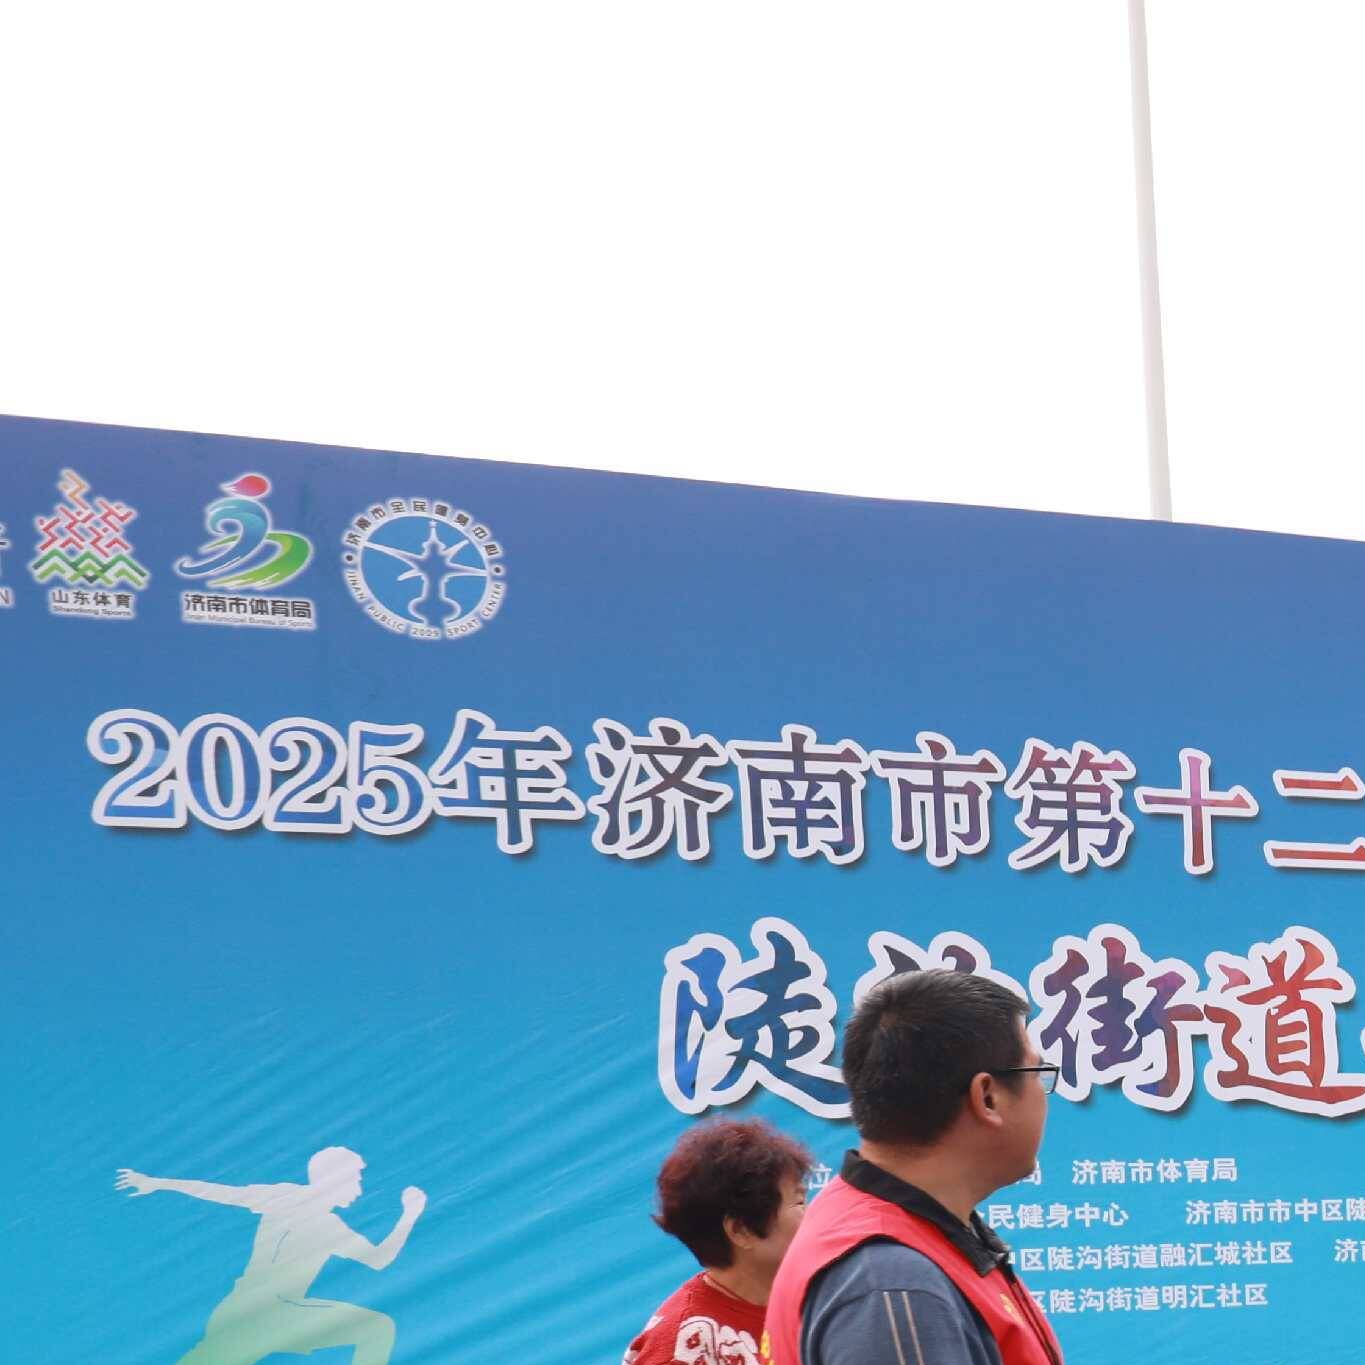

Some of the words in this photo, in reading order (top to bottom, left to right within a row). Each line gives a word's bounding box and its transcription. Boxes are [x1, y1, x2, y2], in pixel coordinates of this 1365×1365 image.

[52, 589, 133, 608] 山东体育
[184, 593, 312, 619] 济南市体育局
[367, 605, 403, 631] PUBLIC
[446, 618, 480, 637] SPORT
[1072, 1157, 1238, 1185] 济南市体育局
[977, 1202, 1129, 1230] 民健身中心
[1008, 1241, 1293, 1273] 区陡沟街道融汇城社区
